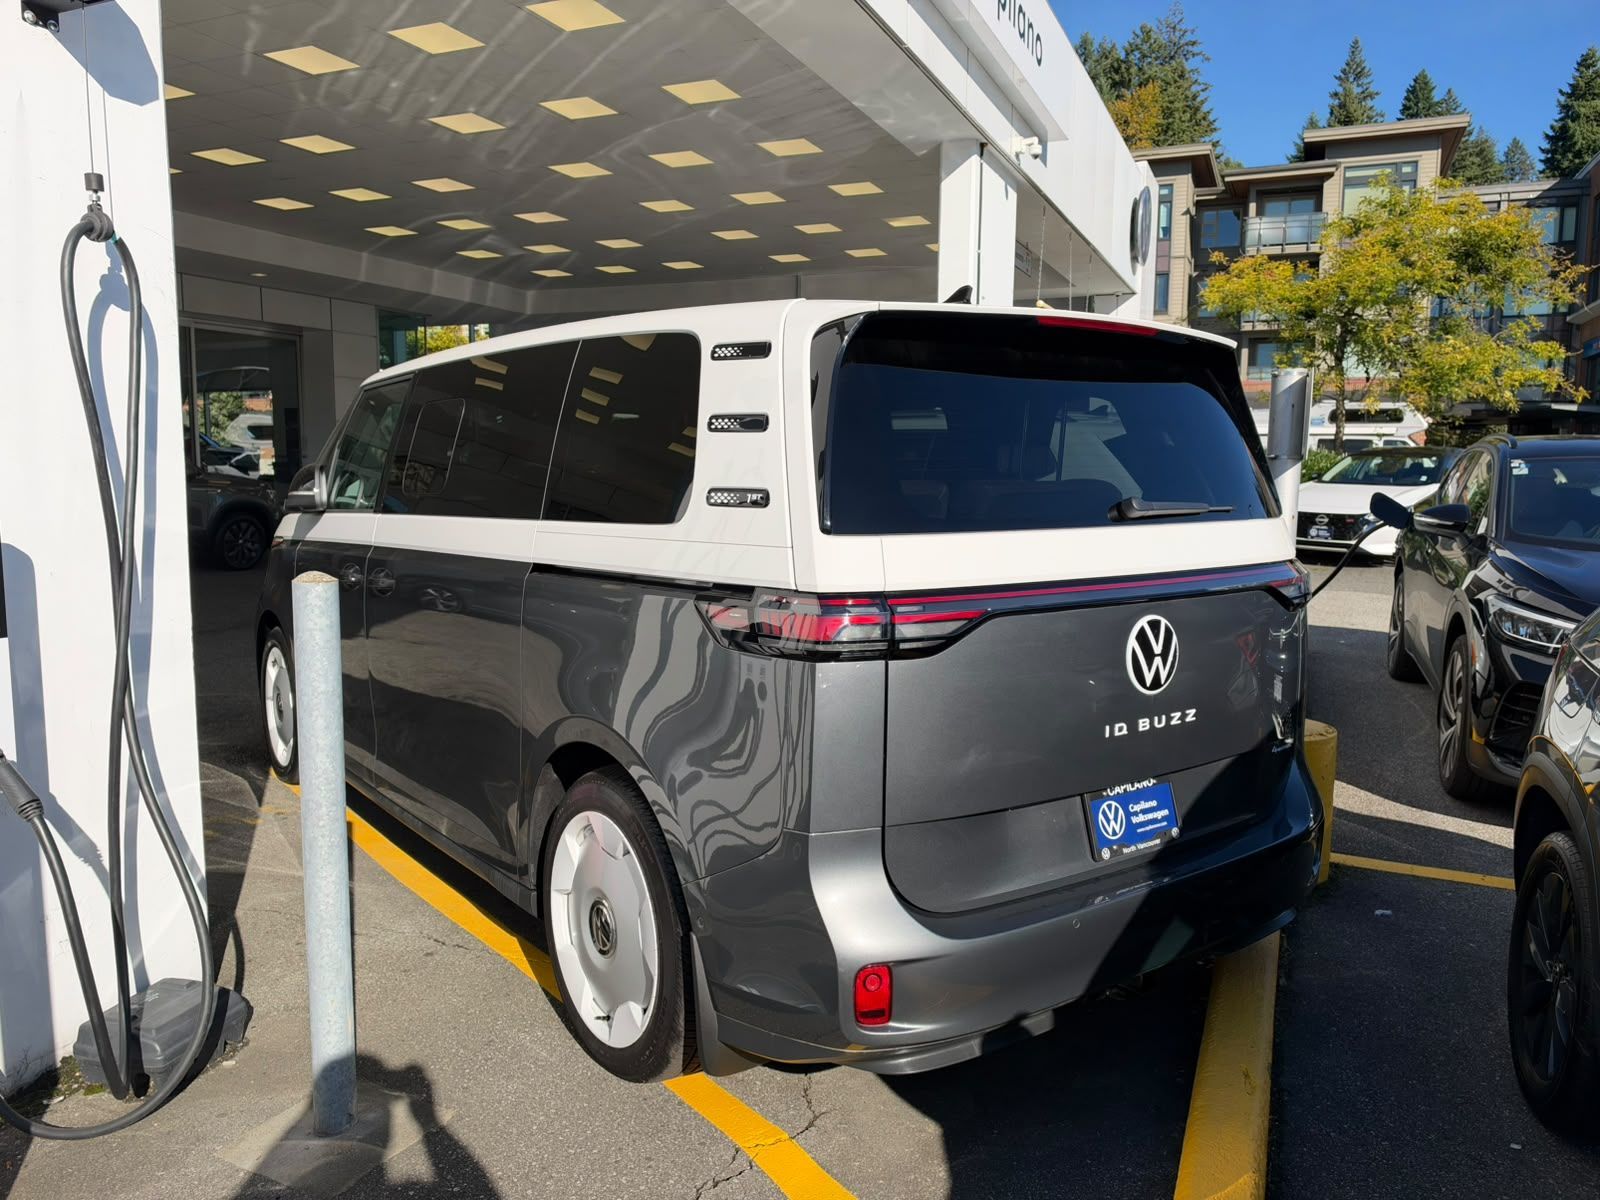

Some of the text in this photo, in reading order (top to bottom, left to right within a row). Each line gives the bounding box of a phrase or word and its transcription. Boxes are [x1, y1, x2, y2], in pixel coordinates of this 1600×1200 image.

[1126, 614, 1179, 695] VW
[1138, 708, 1197, 732] BUZZ
[1129, 800, 1157, 812] Capilano
[1131, 809, 1169, 824] Volkswagen
